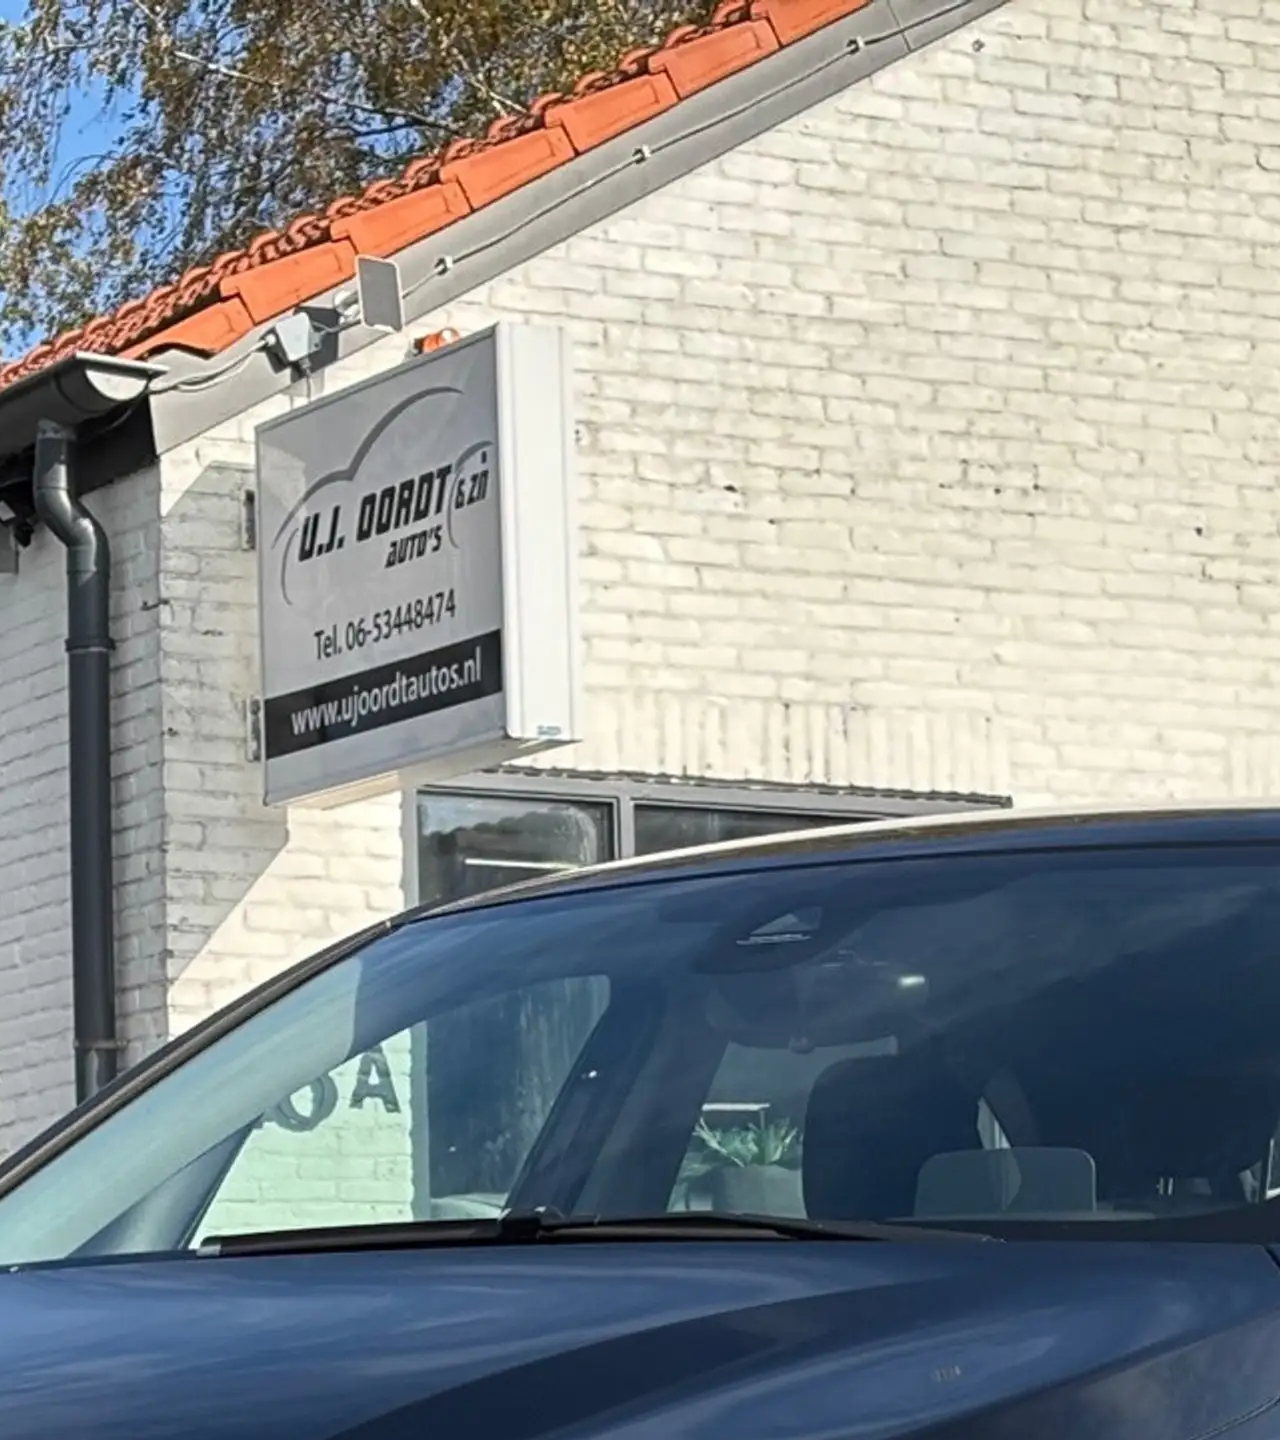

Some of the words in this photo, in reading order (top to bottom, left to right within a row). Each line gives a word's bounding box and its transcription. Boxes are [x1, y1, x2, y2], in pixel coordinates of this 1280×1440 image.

[298, 505, 345, 562] U.J.
[356, 463, 452, 542] OORDT
[313, 627, 343, 661] Tel.
[346, 588, 456, 650] 06-53448474
[291, 646, 481, 734] www.ujoordtautos.nl
